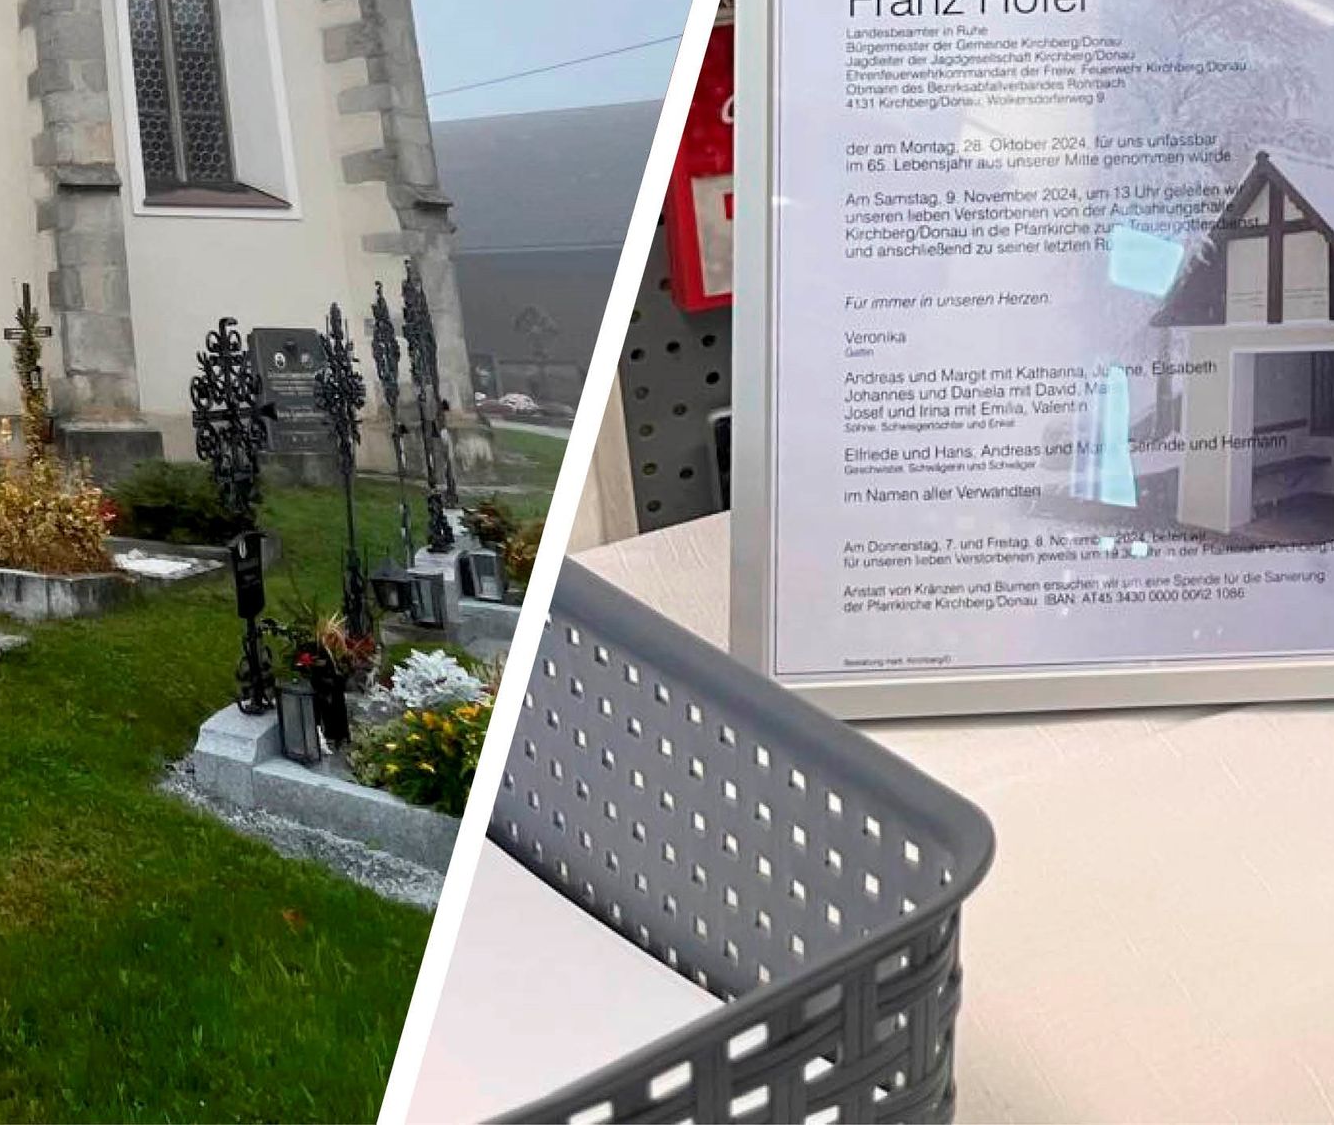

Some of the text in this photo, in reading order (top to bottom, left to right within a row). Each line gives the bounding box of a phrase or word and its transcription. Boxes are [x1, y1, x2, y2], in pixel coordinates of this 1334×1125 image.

[943, 27, 953, 36] in
[934, 41, 951, 51] der
[909, 55, 926, 64] der
[1021, 66, 1039, 76] der
[846, 143, 868, 156] der
[873, 144, 895, 154] am
[990, 138, 1046, 151] Oktober
[1118, 136, 1142, 147] uns
[1147, 134, 1217, 147] unfassbar
[846, 150, 1230, 172] im Lebensjahr aus unserer Mitte genommen wurde
[846, 193, 869, 206] Am
[964, 189, 1037, 203] November
[1086, 188, 1109, 200] um
[1114, 186, 1130, 198] 13
[1135, 185, 1160, 198] Uhr
[846, 204, 1105, 223] unseren lieben Verstorbenen von der
[846, 226, 967, 241] Kirchberg/Donau
[972, 225, 983, 236] in
[988, 224, 1010, 236] die
[846, 245, 872, 258] und
[877, 242, 971, 257] anschließend
[976, 244, 992, 254] zu
[997, 241, 1040, 254] seiner
[1044, 238, 1091, 252] letzten
[871, 295, 916, 309] immer
[921, 294, 932, 307] in
[938, 293, 994, 307] unseren
[845, 331, 906, 344] Veronika
[845, 371, 904, 384] Andreas
[909, 370, 936, 383] und
[941, 368, 986, 384] Margit
[991, 367, 1011, 380] mit
[845, 383, 1030, 402] Johannes und Daniela mit
[845, 406, 883, 419] Josef
[888, 404, 915, 417] und
[920, 403, 949, 416] Irina
[955, 402, 975, 415] mit
[903, 447, 930, 459] und
[981, 444, 1040, 456] Andreas
[1045, 442, 1072, 454] und
[1190, 437, 1217, 450] und
[868, 489, 918, 503] Namen
[923, 487, 952, 500] aller
[956, 485, 1040, 499] Verwandten
[961, 538, 982, 550] und
[864, 556, 911, 567] unseren
[969, 582, 990, 594] und
[995, 581, 1039, 593] Blumen
